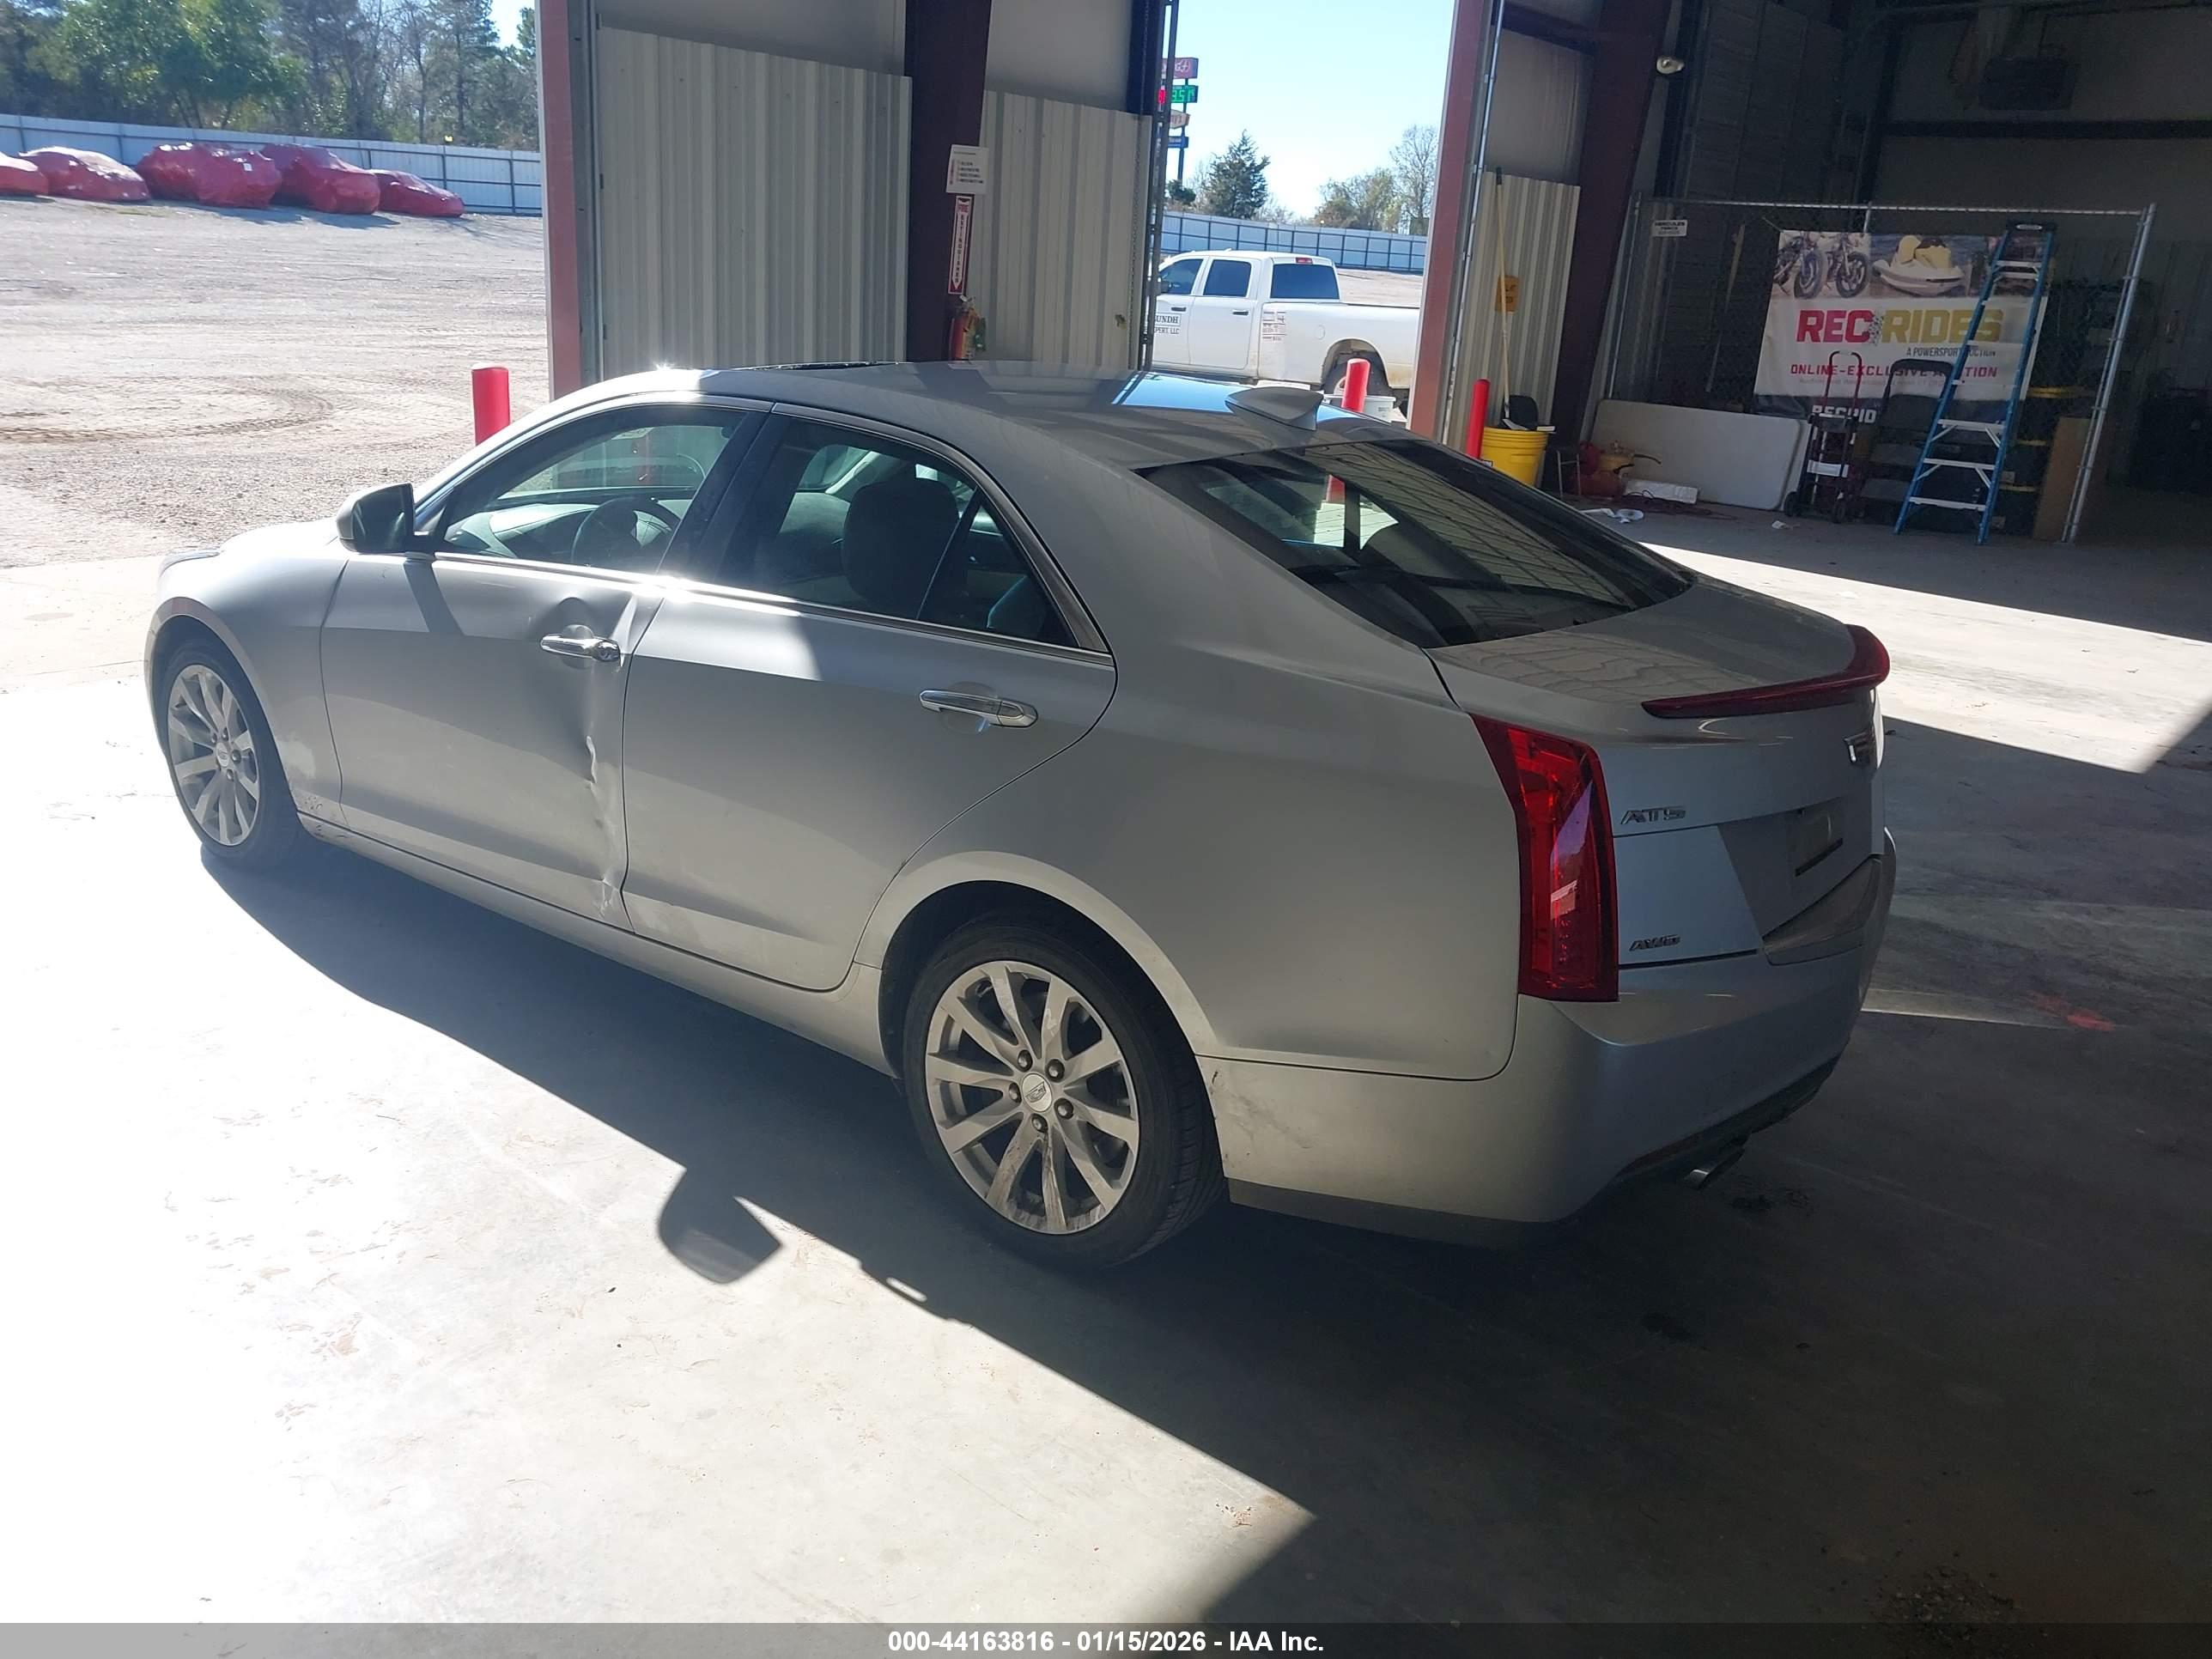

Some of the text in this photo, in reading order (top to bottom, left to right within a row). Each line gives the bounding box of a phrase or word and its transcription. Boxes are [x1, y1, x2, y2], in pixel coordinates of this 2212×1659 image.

[1155, 315, 1179, 324] UNDH
[1796, 309, 2003, 343] REC RIDES
[1906, 347, 1912, 357] A
[1913, 347, 1960, 357] POWERSPOR
[1620, 805, 1686, 824] ATS
